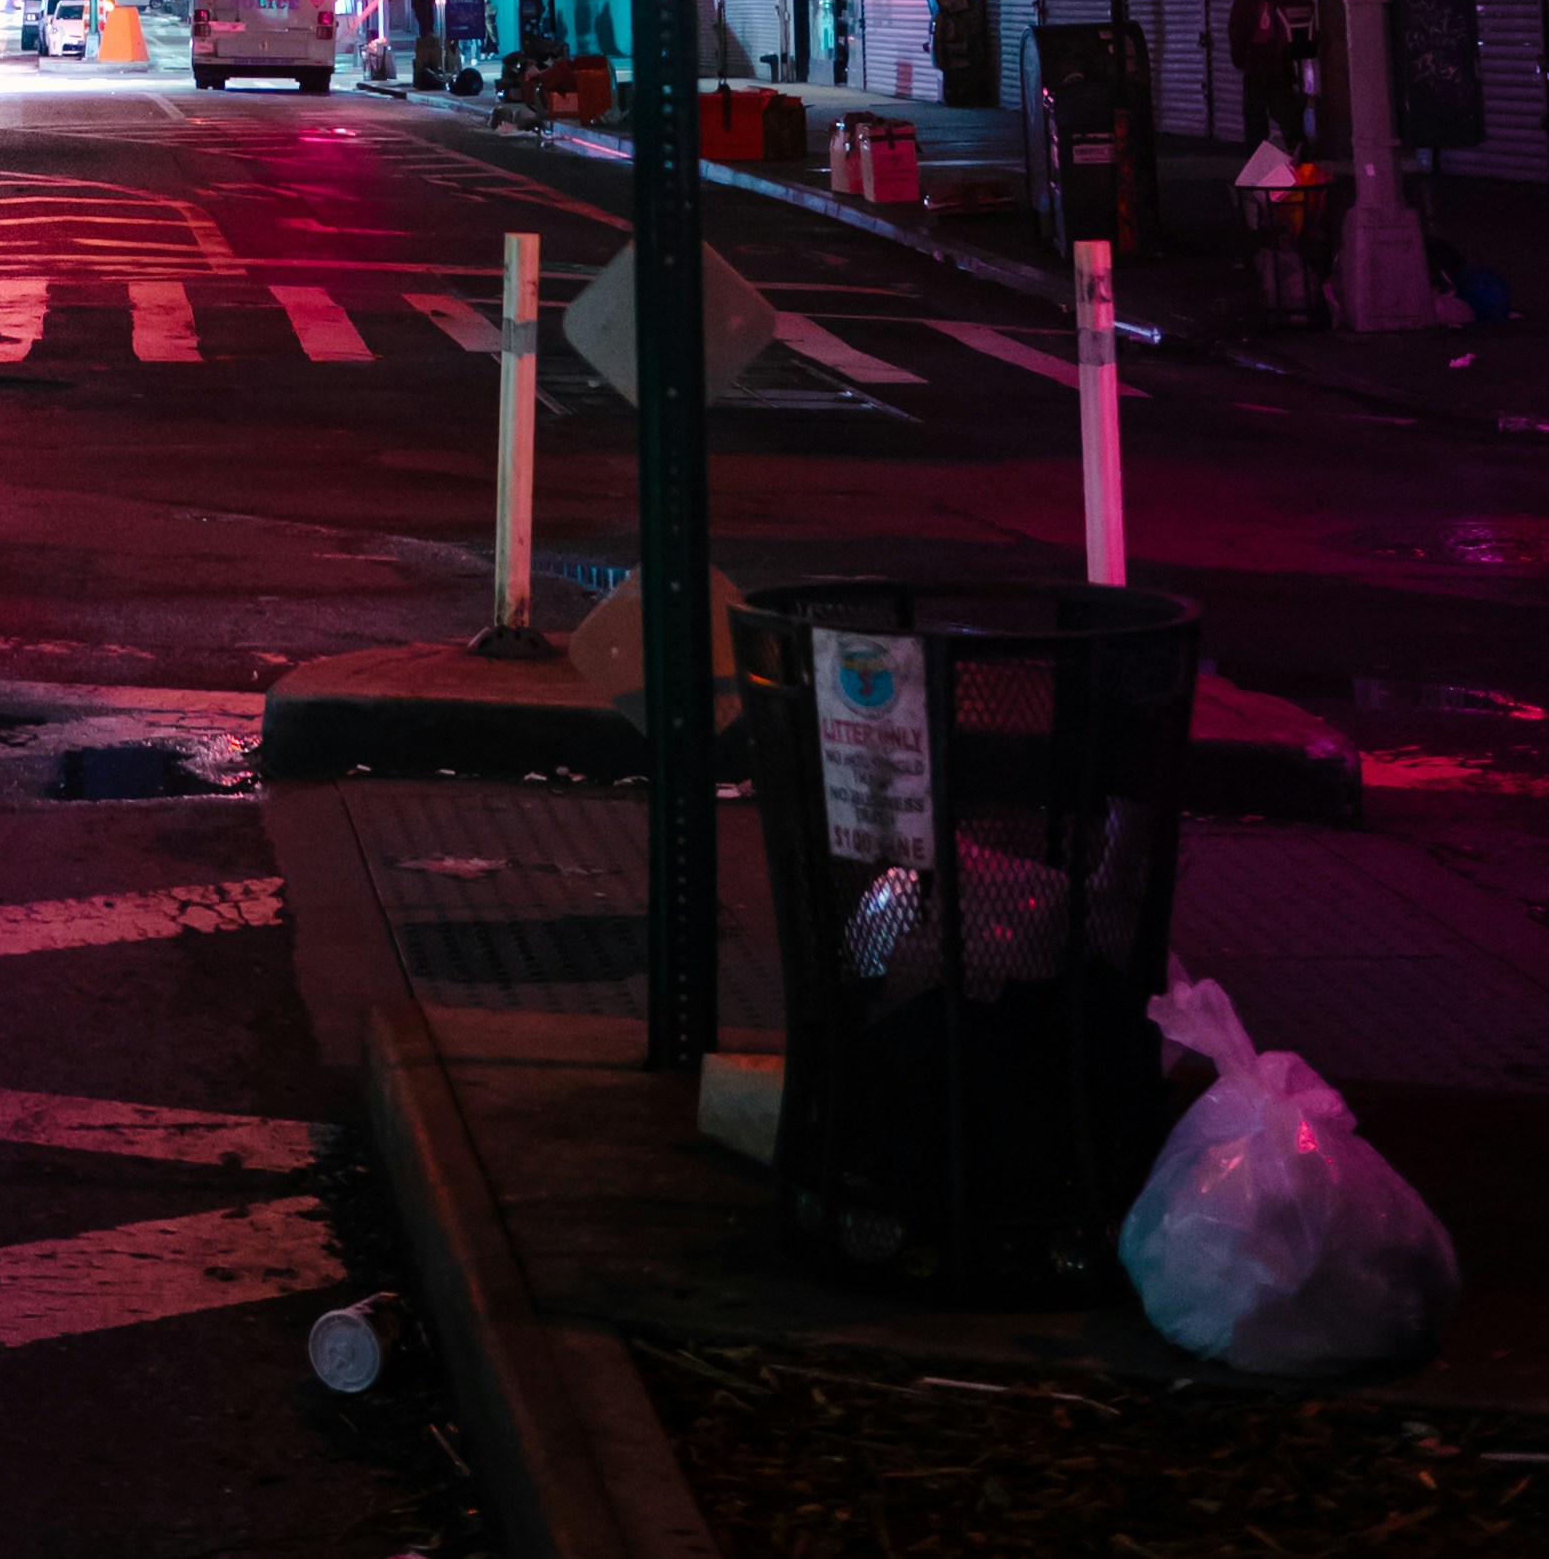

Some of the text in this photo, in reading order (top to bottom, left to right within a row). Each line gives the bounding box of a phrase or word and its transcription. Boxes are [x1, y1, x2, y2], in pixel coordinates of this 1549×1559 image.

[823, 718, 872, 746] LITTER
[830, 786, 925, 813] NO BUESS
